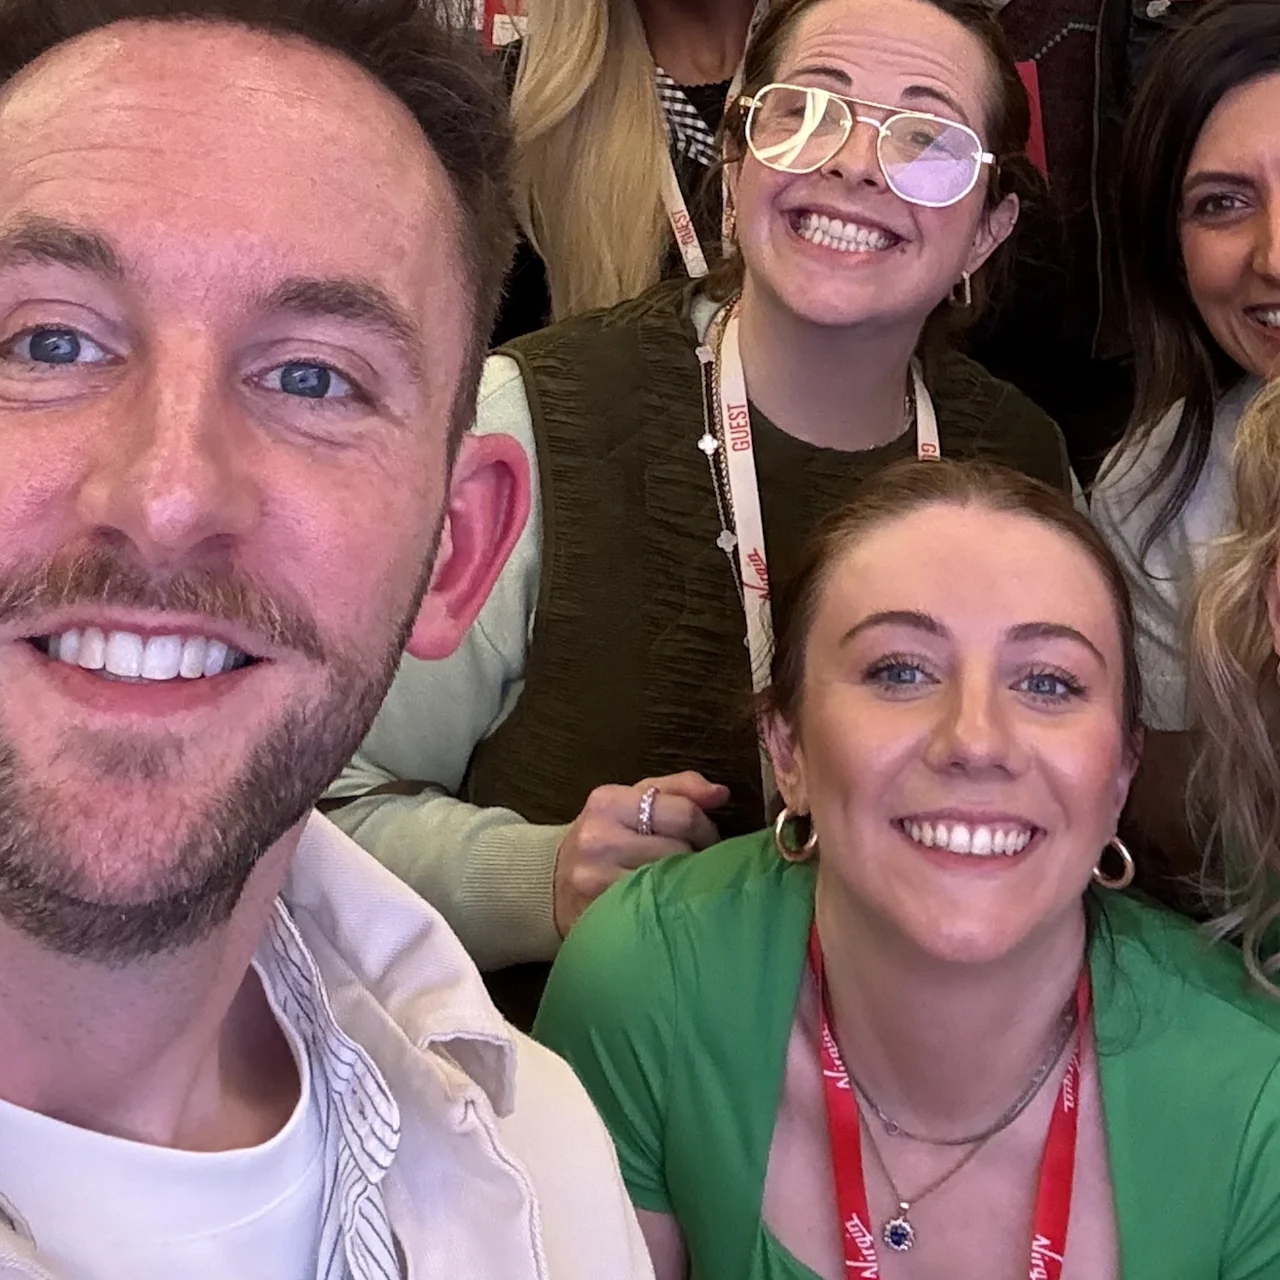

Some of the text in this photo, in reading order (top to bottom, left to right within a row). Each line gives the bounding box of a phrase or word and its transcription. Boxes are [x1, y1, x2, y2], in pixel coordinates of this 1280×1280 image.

[672, 209, 696, 247] GUEST
[727, 402, 751, 452] GUEST
[742, 548, 772, 601] Virgin
[820, 1023, 852, 1089] Virgin
[844, 1212, 879, 1280] Virgin
[1029, 1233, 1064, 1280] Virg
